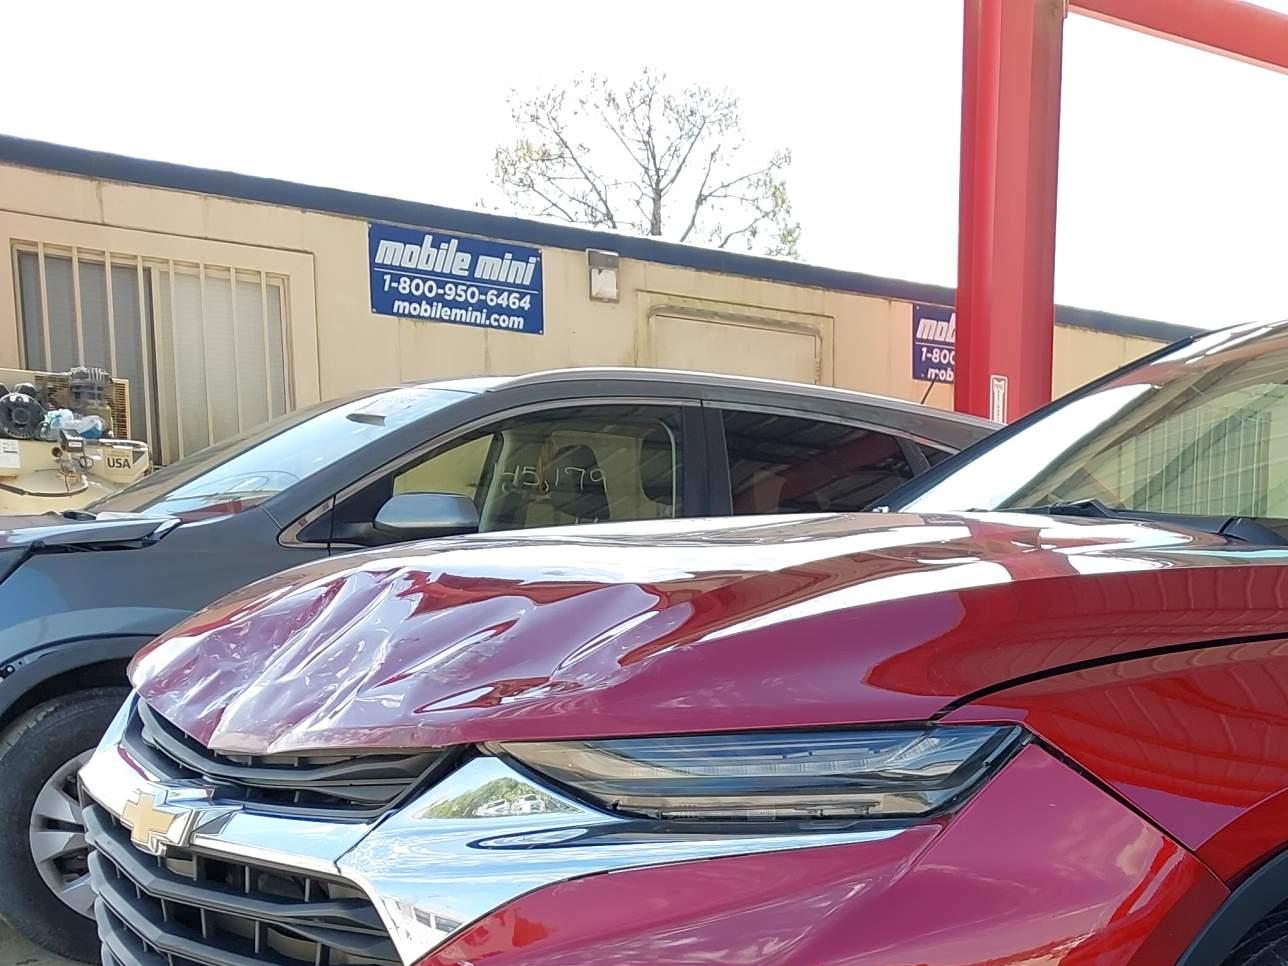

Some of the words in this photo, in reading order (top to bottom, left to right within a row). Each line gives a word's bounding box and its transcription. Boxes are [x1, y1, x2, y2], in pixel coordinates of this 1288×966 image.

[375, 235, 471, 276] mobile
[474, 253, 537, 285] mini
[383, 274, 531, 311] 1-800-950-6464
[393, 300, 524, 329] mobilemini.com
[107, 457, 131, 469] USA
